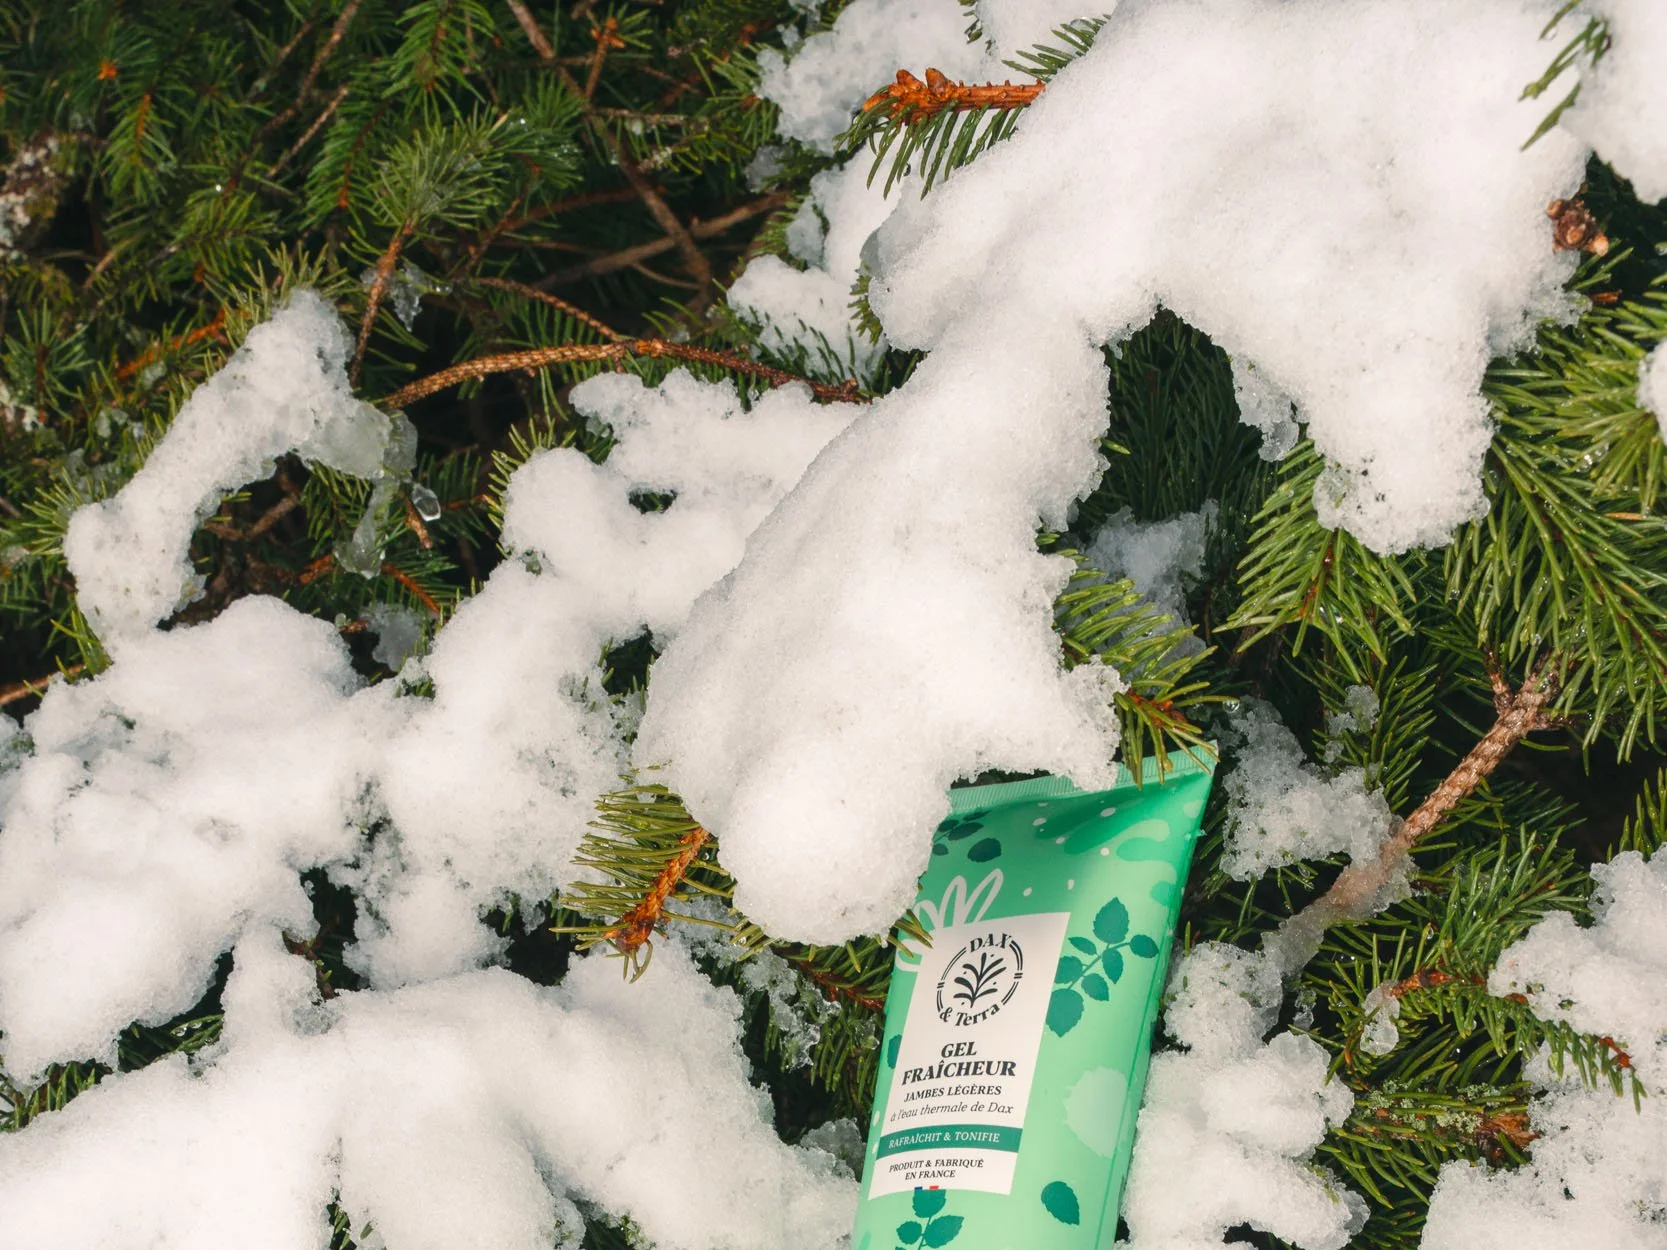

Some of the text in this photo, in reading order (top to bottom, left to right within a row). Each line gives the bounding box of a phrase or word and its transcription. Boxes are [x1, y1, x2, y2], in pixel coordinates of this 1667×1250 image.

[970, 933, 1012, 953] DAX
[940, 1003, 1000, 1027] & Terra
[941, 1041, 977, 1058] GEL
[902, 1060, 1017, 1085] FRAÎCHEUR
[904, 1083, 1002, 1102] JAMBES LÉGÈRES
[920, 1101, 968, 1116] thermale
[970, 1101, 985, 1112] de
[988, 1102, 1014, 1114] Dax
[888, 1131, 1000, 1149] RAFRAÎCHIT & TONIFIE
[889, 1158, 984, 1173] PRODUIT & FABRIQUÉ
[905, 1169, 956, 1181] EN FRANCE
